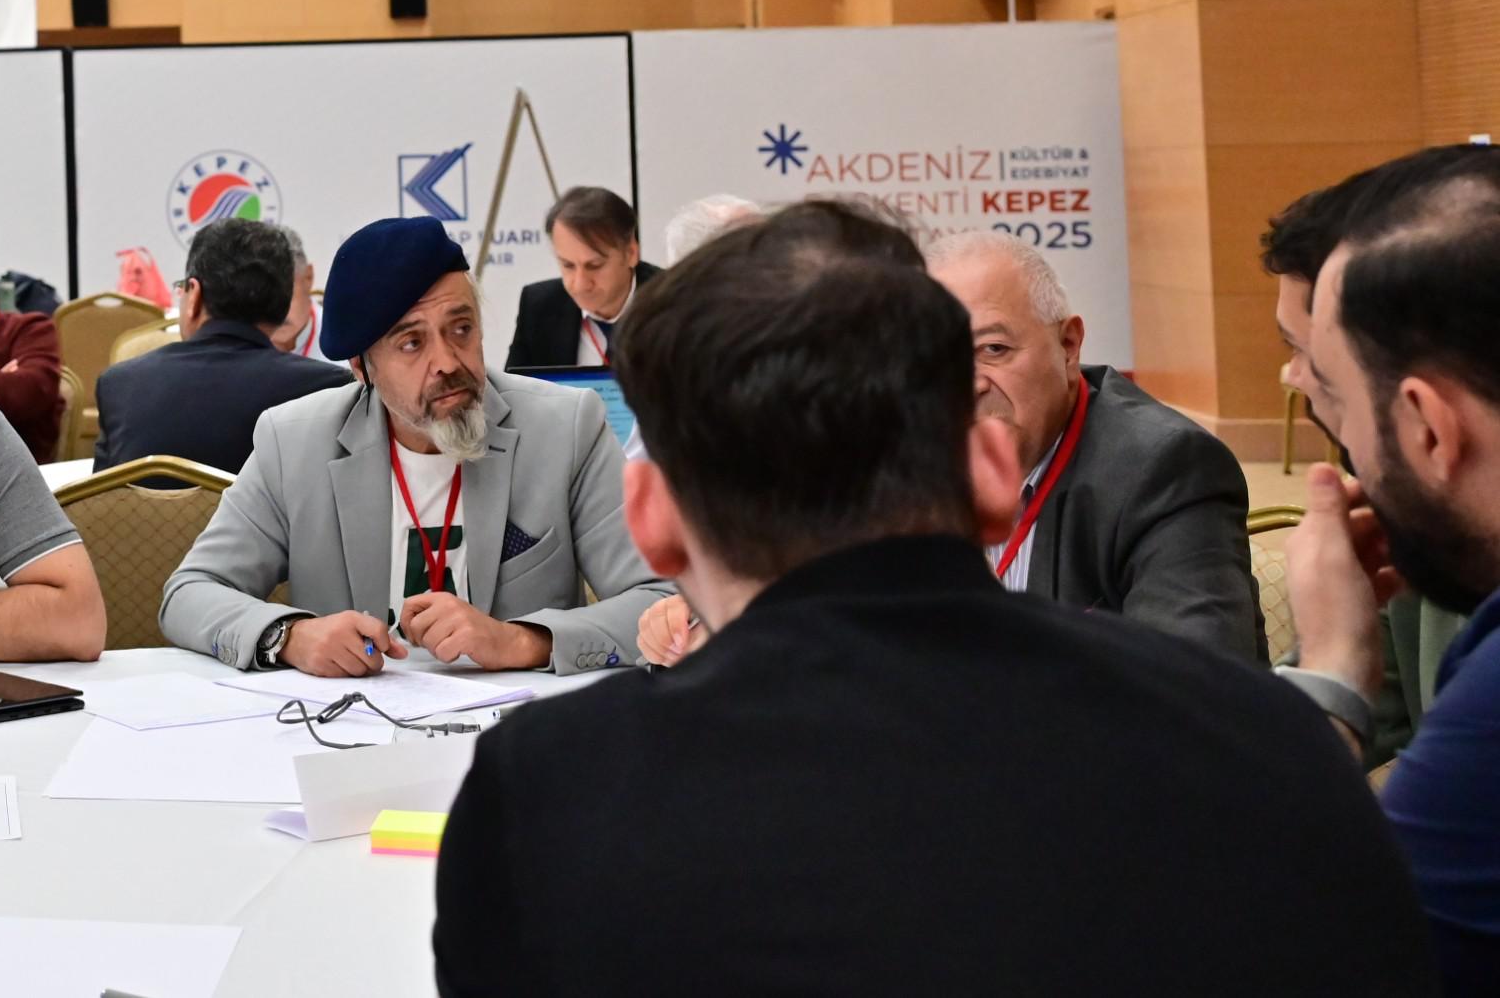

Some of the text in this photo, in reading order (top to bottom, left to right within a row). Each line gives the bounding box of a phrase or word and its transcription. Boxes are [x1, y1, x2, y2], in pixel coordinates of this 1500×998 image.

[805, 144, 991, 183] AKDENİZ
[1009, 145, 1090, 161] KÜLTÜR &
[1009, 163, 1090, 180] EDEBİYAT
[982, 188, 1090, 214] KEPEZ
